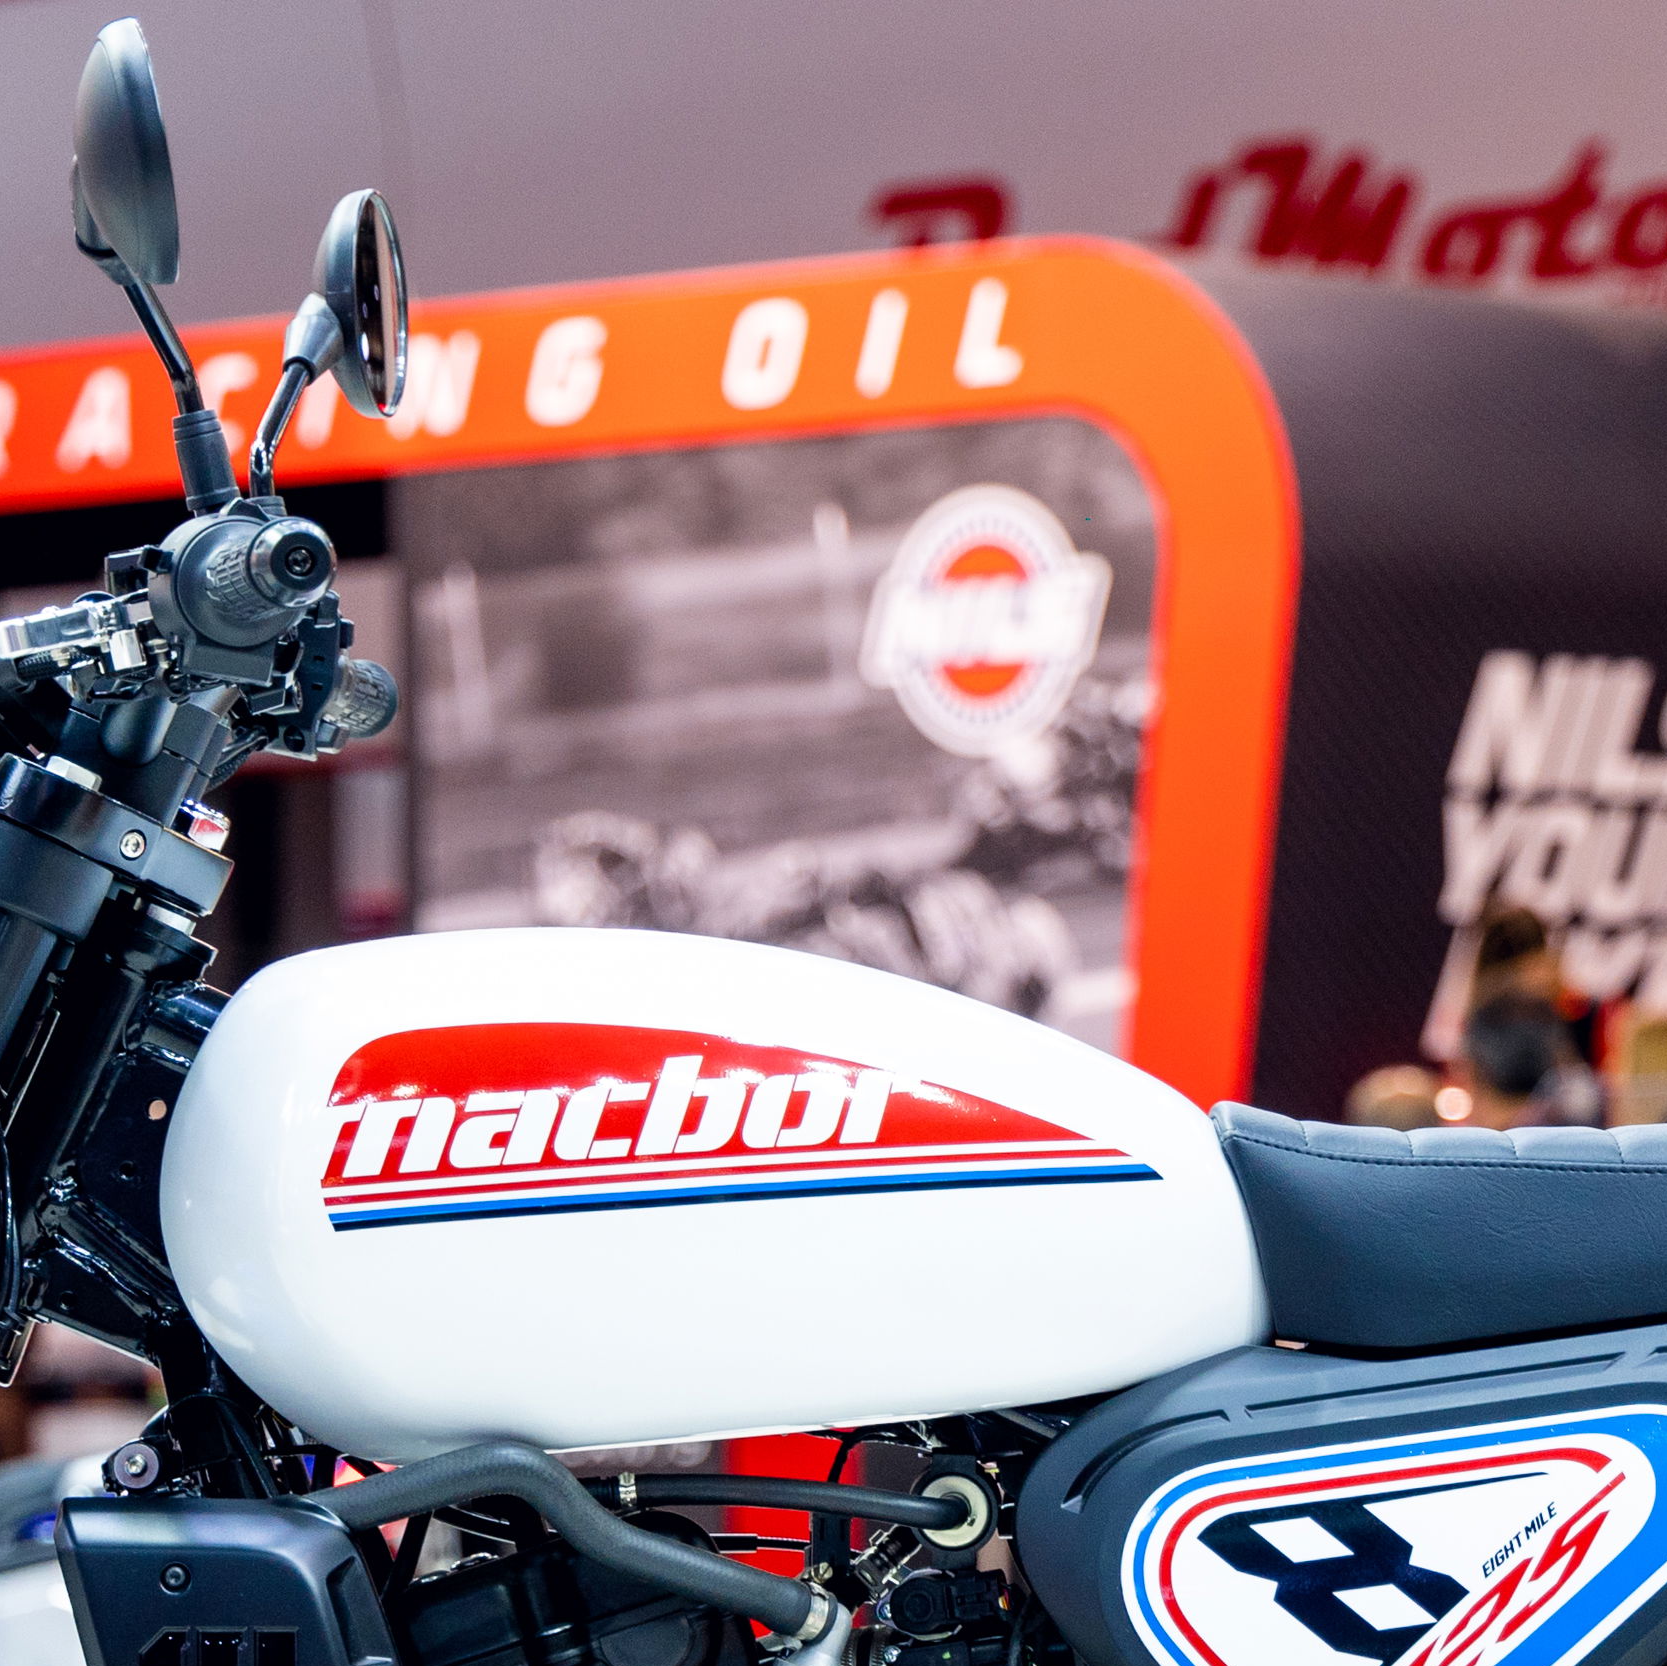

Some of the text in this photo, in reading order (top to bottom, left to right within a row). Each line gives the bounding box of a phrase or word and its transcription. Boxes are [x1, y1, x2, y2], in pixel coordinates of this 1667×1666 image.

[719, 277, 1025, 411] OIL
[1482, 1501, 1558, 1579] EIGHT MILE
